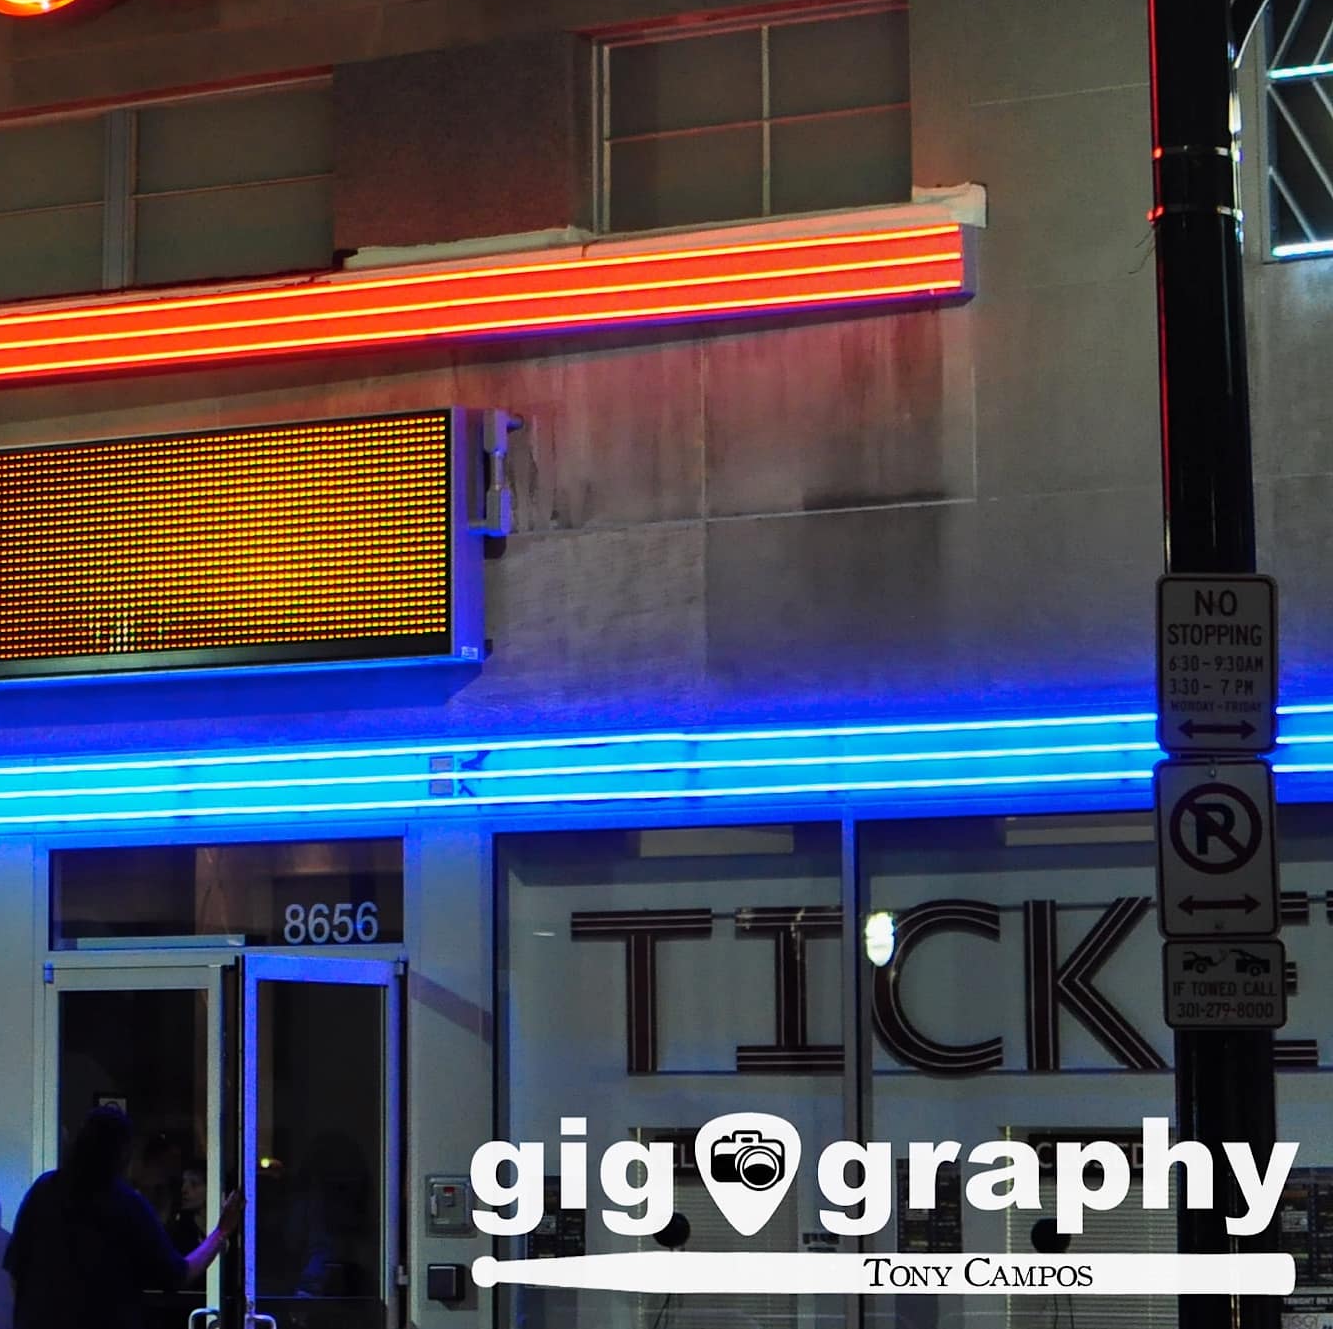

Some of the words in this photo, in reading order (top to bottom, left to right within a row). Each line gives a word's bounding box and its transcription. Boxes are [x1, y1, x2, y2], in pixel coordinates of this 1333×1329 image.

[1195, 590, 1237, 616] NO
[1167, 624, 1262, 646] STOPPING
[284, 901, 378, 944] 8656
[1192, 981, 1237, 997] TOWED
[1244, 982, 1278, 997] CALL
[1177, 1002, 1274, 1018] 301-279-8000
